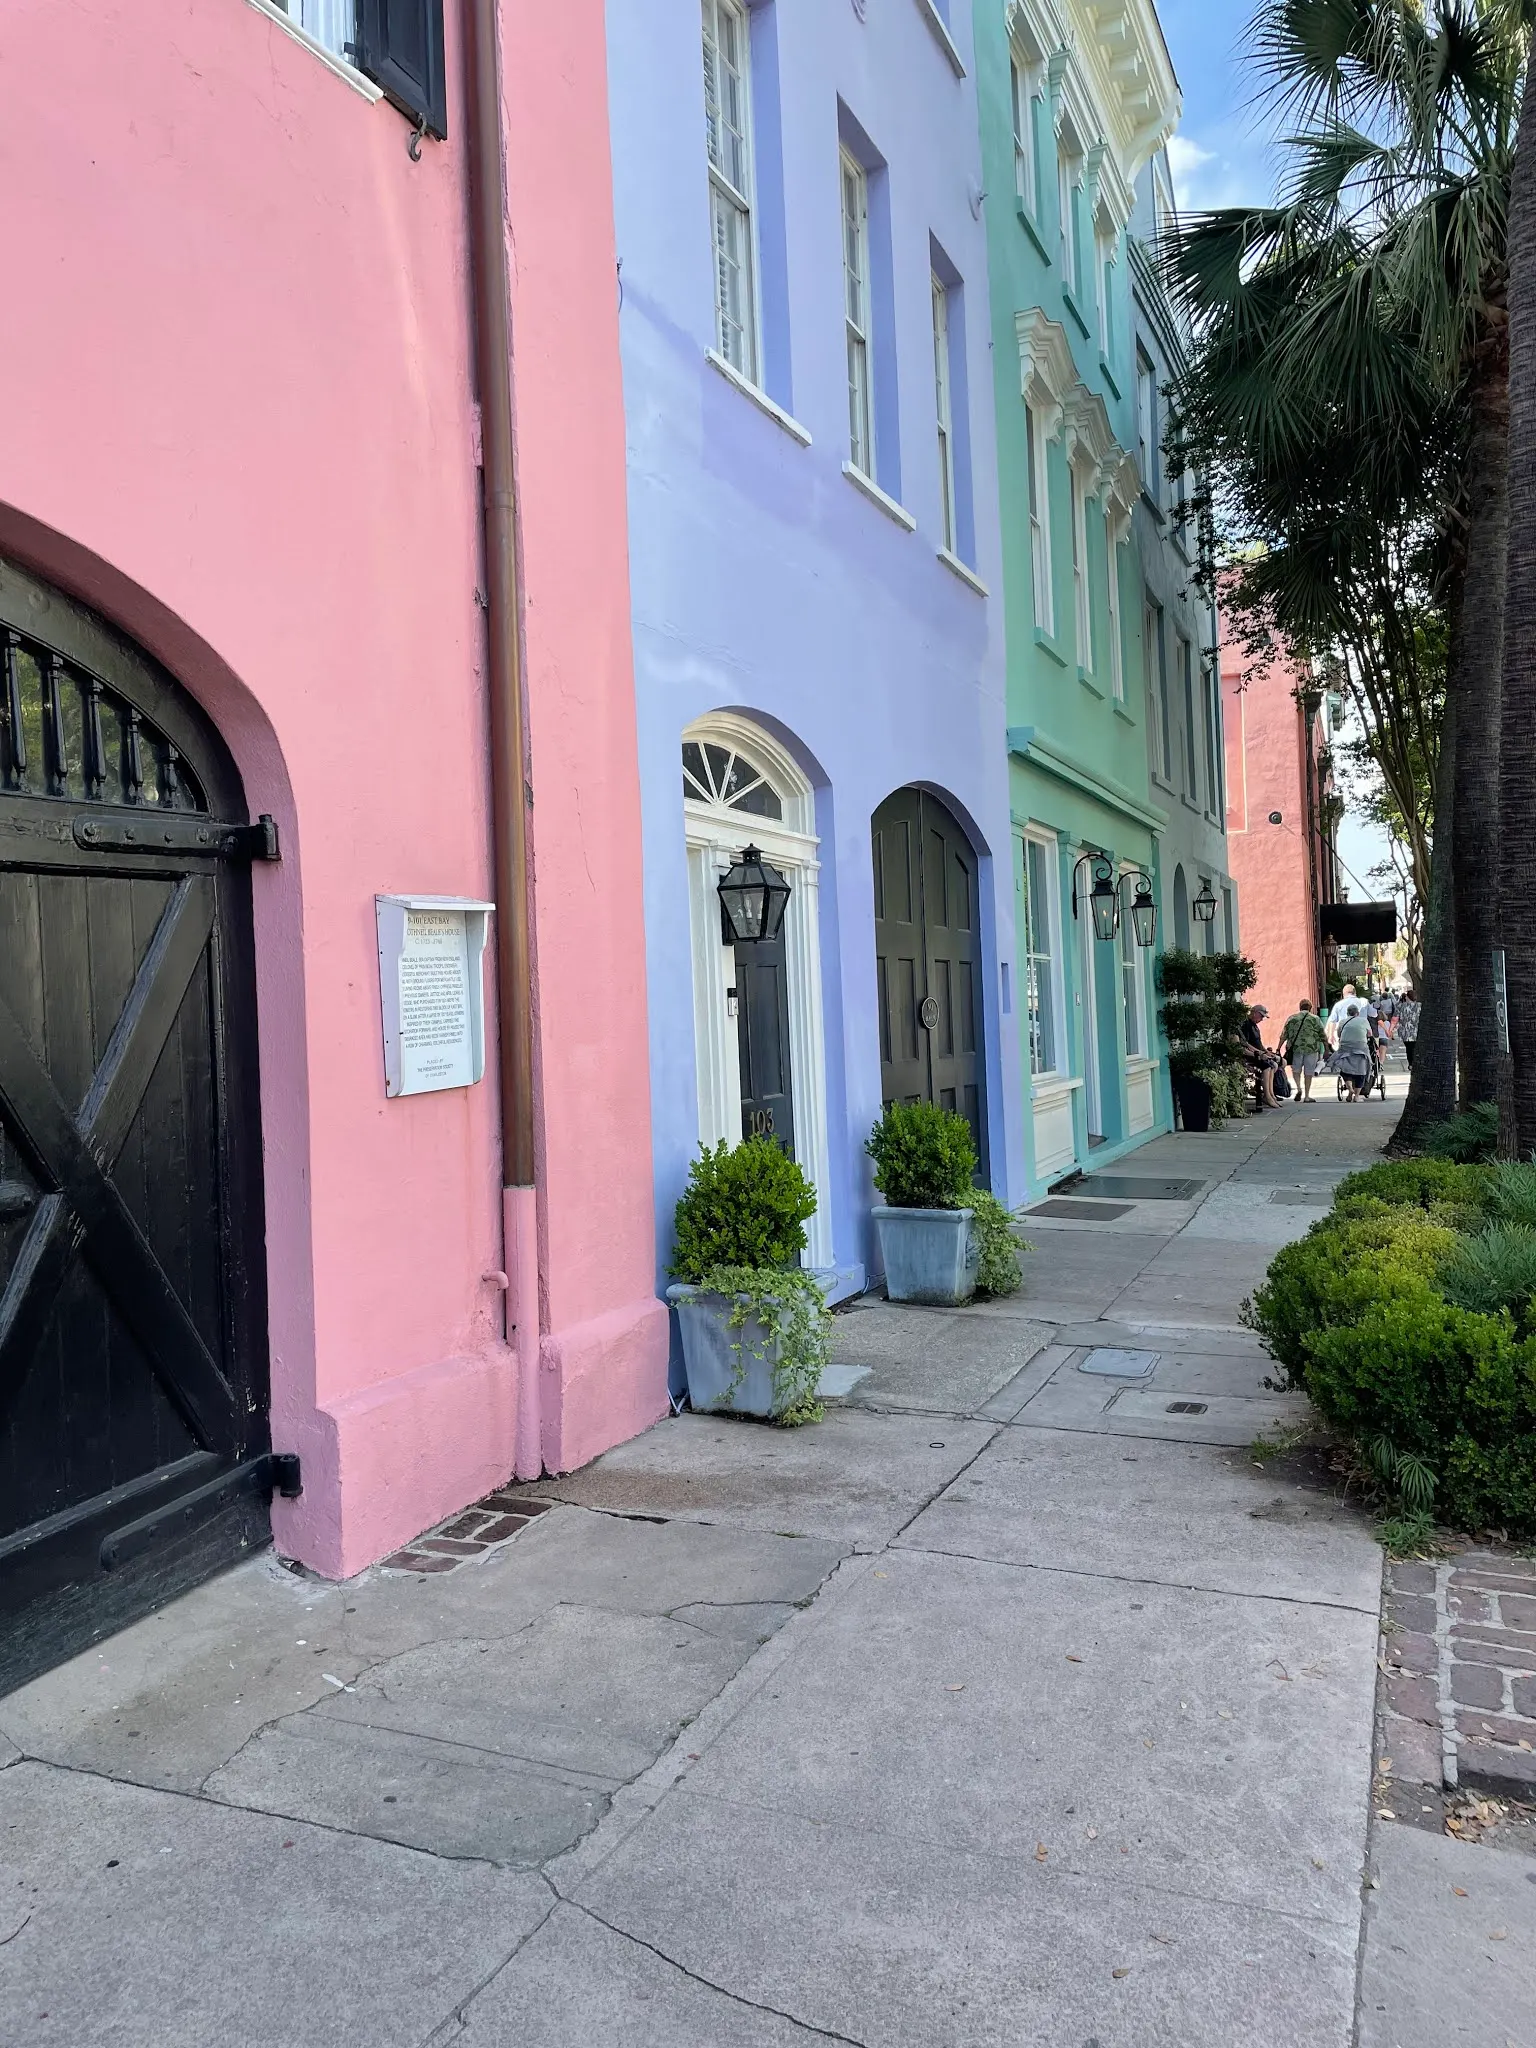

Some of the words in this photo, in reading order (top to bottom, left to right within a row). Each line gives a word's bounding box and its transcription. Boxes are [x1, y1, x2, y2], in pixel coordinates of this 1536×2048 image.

[424, 916, 438, 925] EAST
[439, 916, 450, 925] BAY
[750, 1107, 775, 1135] 103
